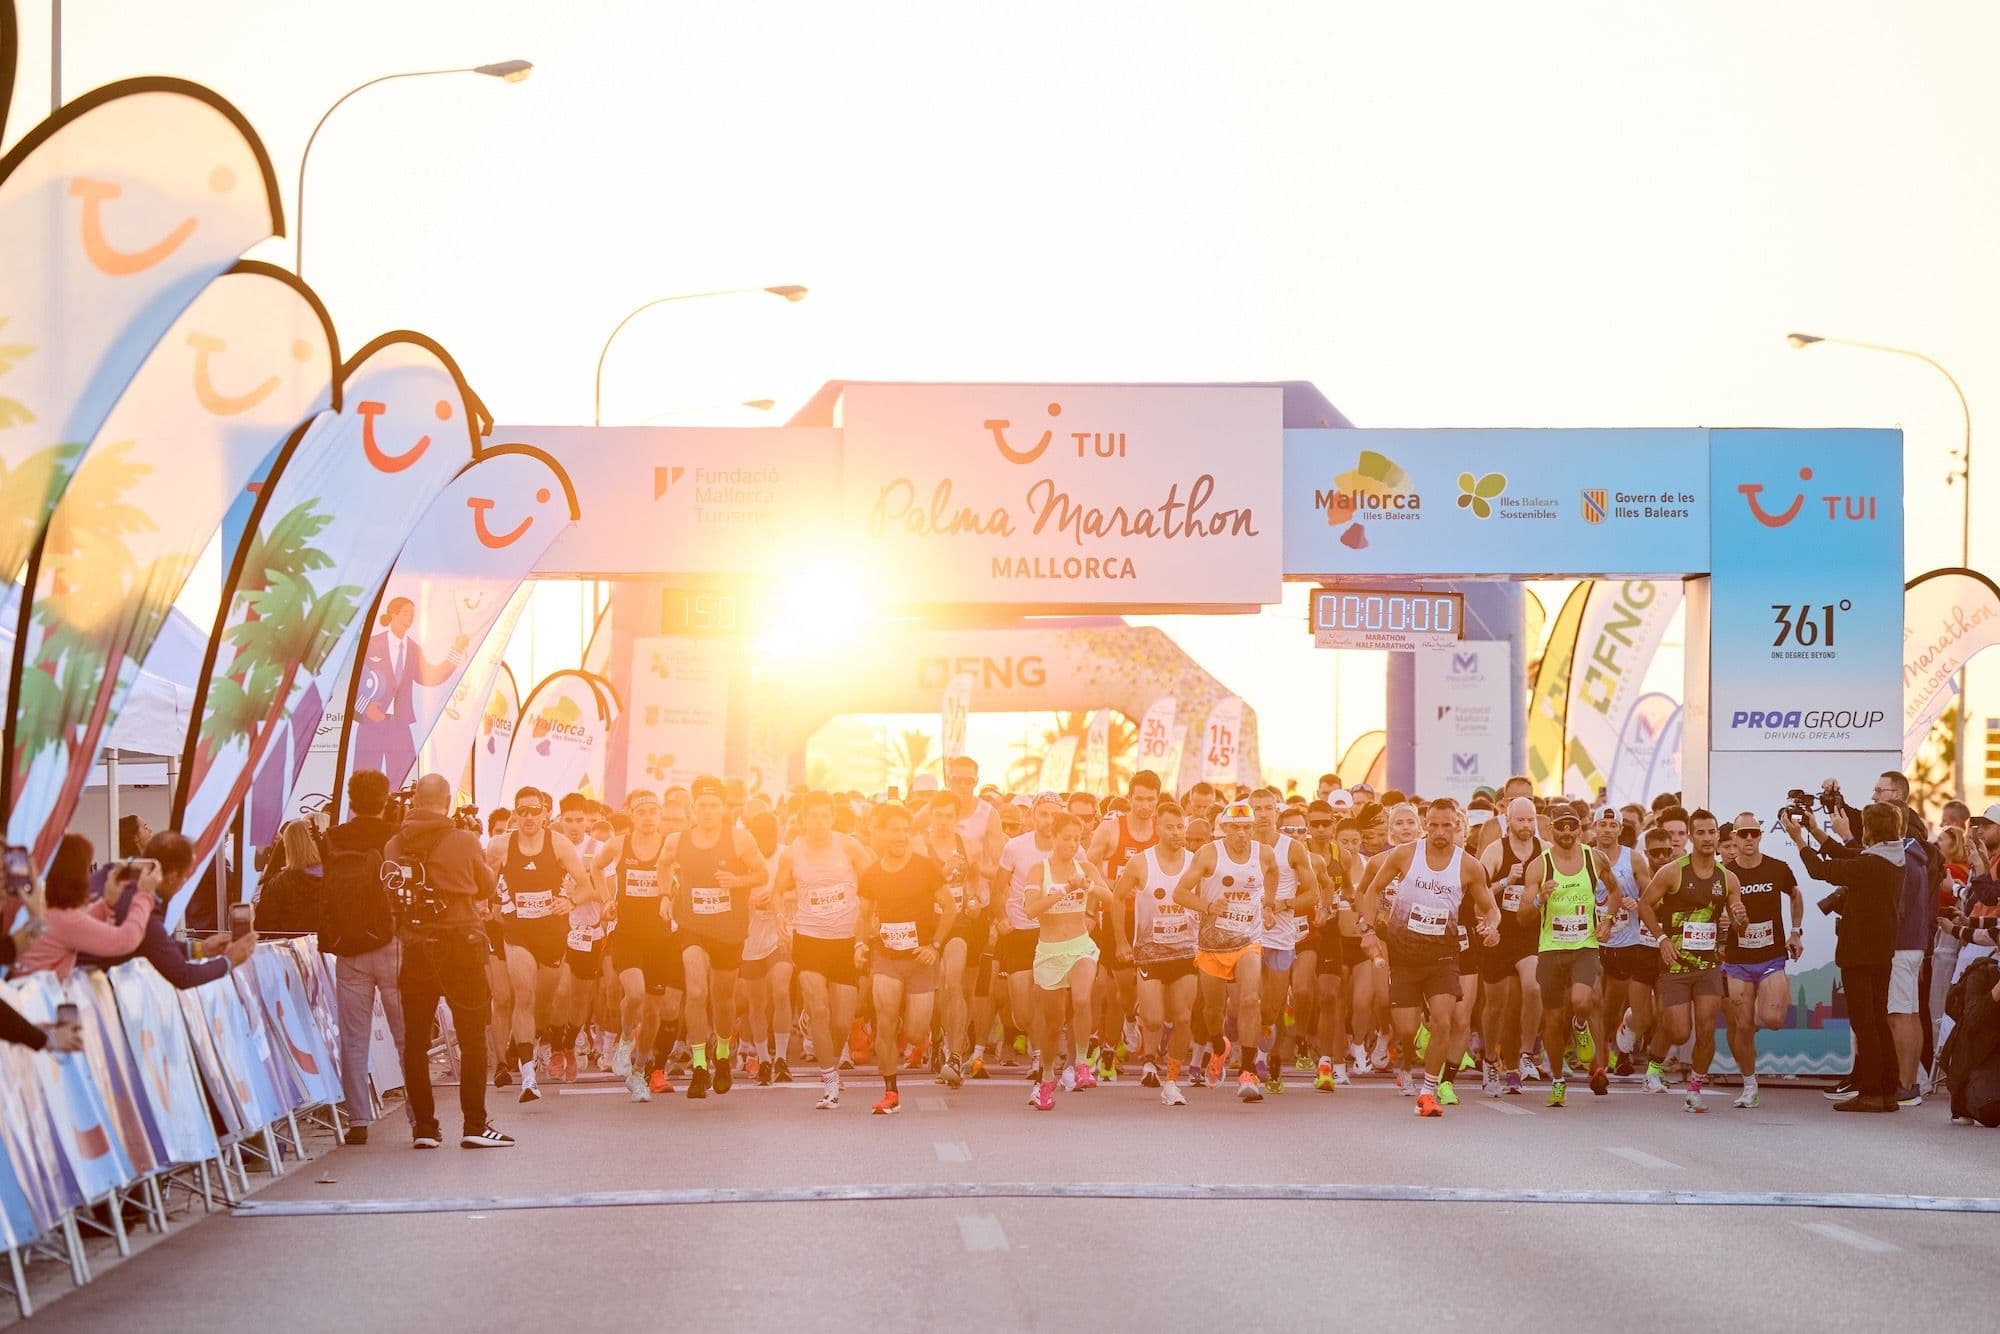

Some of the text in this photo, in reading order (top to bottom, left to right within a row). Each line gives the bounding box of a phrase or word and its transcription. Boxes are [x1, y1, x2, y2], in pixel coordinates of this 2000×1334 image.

[1072, 433, 1126, 457] TUI
[1315, 490, 1420, 510] Mallorca
[1500, 498, 1559, 507] Illes Balears
[1615, 492, 1694, 503] Govern de les
[869, 473, 1259, 546] Palma Marathon
[1615, 507, 1689, 518] Illes Balears
[1823, 496, 1876, 520] TUI
[1363, 512, 1420, 520] Illes Balears
[1500, 511, 1557, 519] Sostenibles
[991, 557, 1137, 579] MALLORCA
[1319, 595, 1453, 631] 00:00:00
[1365, 633, 1406, 642] MARATHON
[1355, 641, 1416, 650] HALF MARATHON
[1771, 652, 1836, 660] ONE DEGREE BEYOND
[1905, 657, 1960, 719] MALLORCA
[1731, 711, 1884, 729] PROA GROUP
[1210, 724, 1231, 745] 1h
[1764, 732, 1850, 740] DRIVING DREAMS
[1739, 882, 1773, 895] ROOKS
